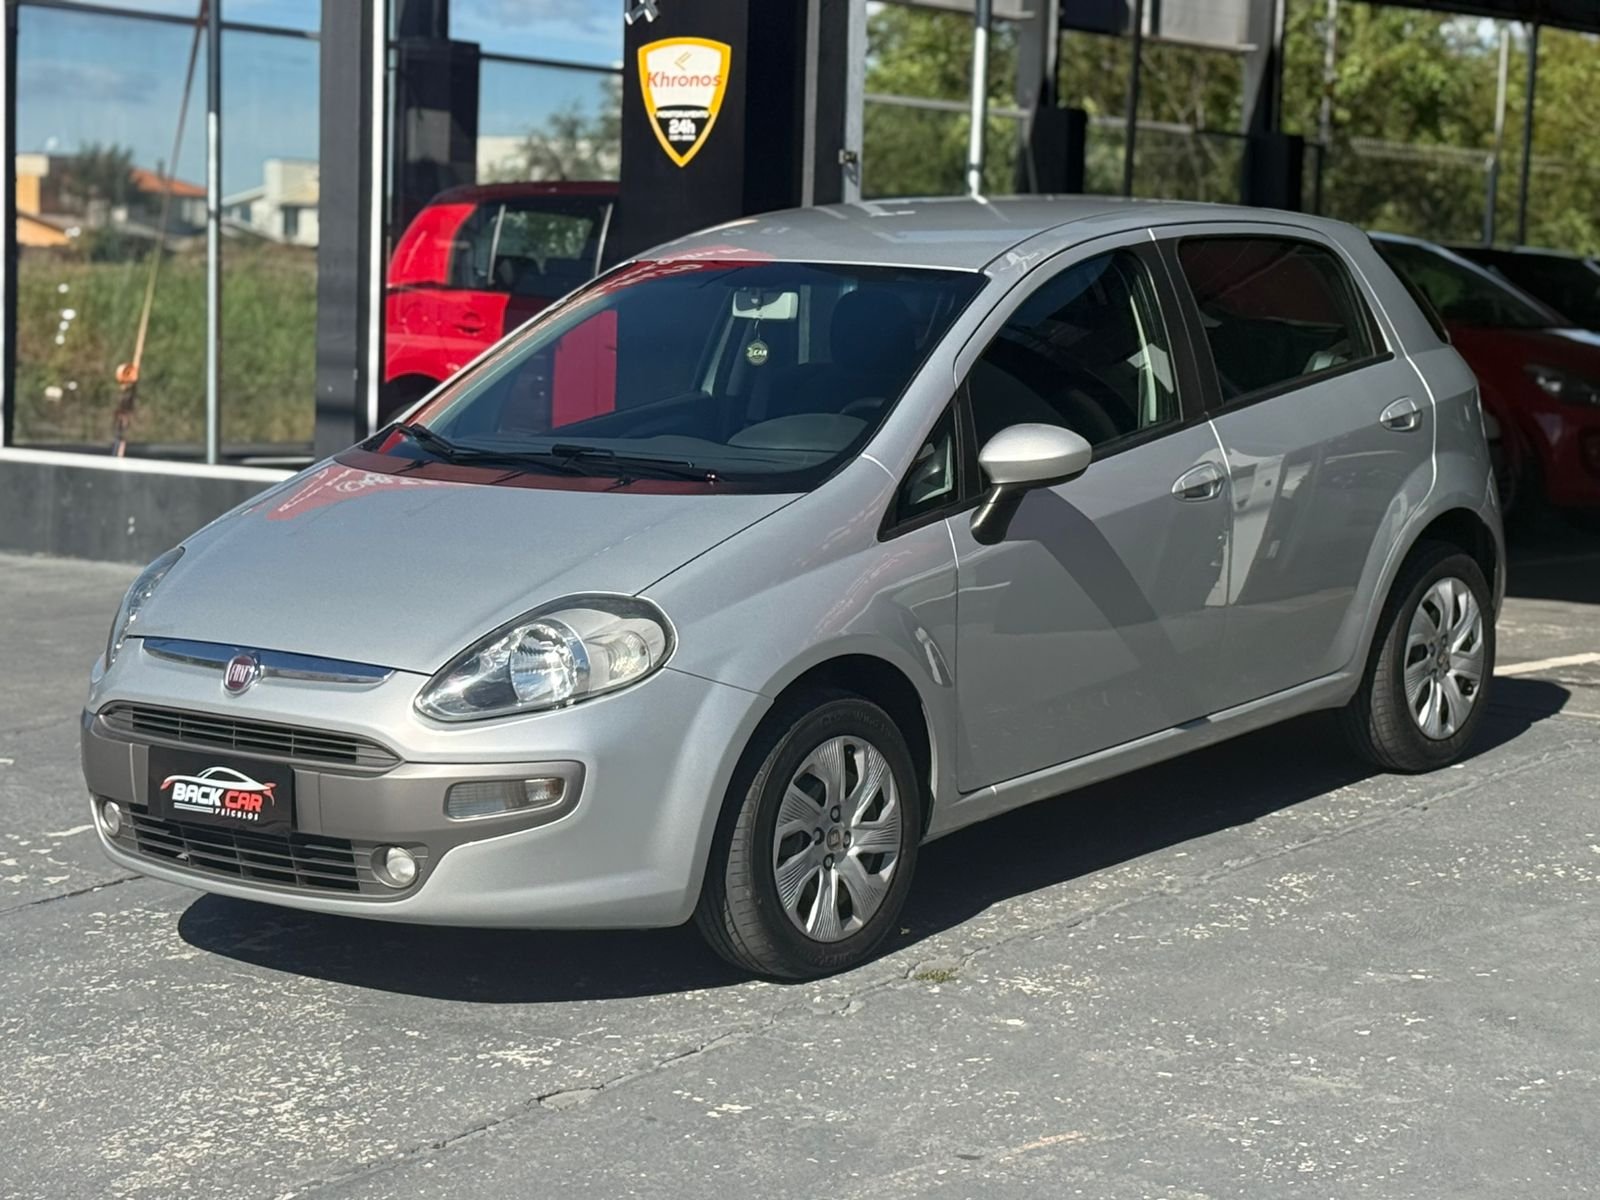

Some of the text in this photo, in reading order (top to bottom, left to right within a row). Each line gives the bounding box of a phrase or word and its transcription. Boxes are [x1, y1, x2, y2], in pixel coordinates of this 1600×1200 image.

[647, 71, 722, 87] Khronos
[669, 119, 696, 134] 24h
[229, 663, 251, 682] FIAT
[172, 782, 263, 812] BACK CAR
